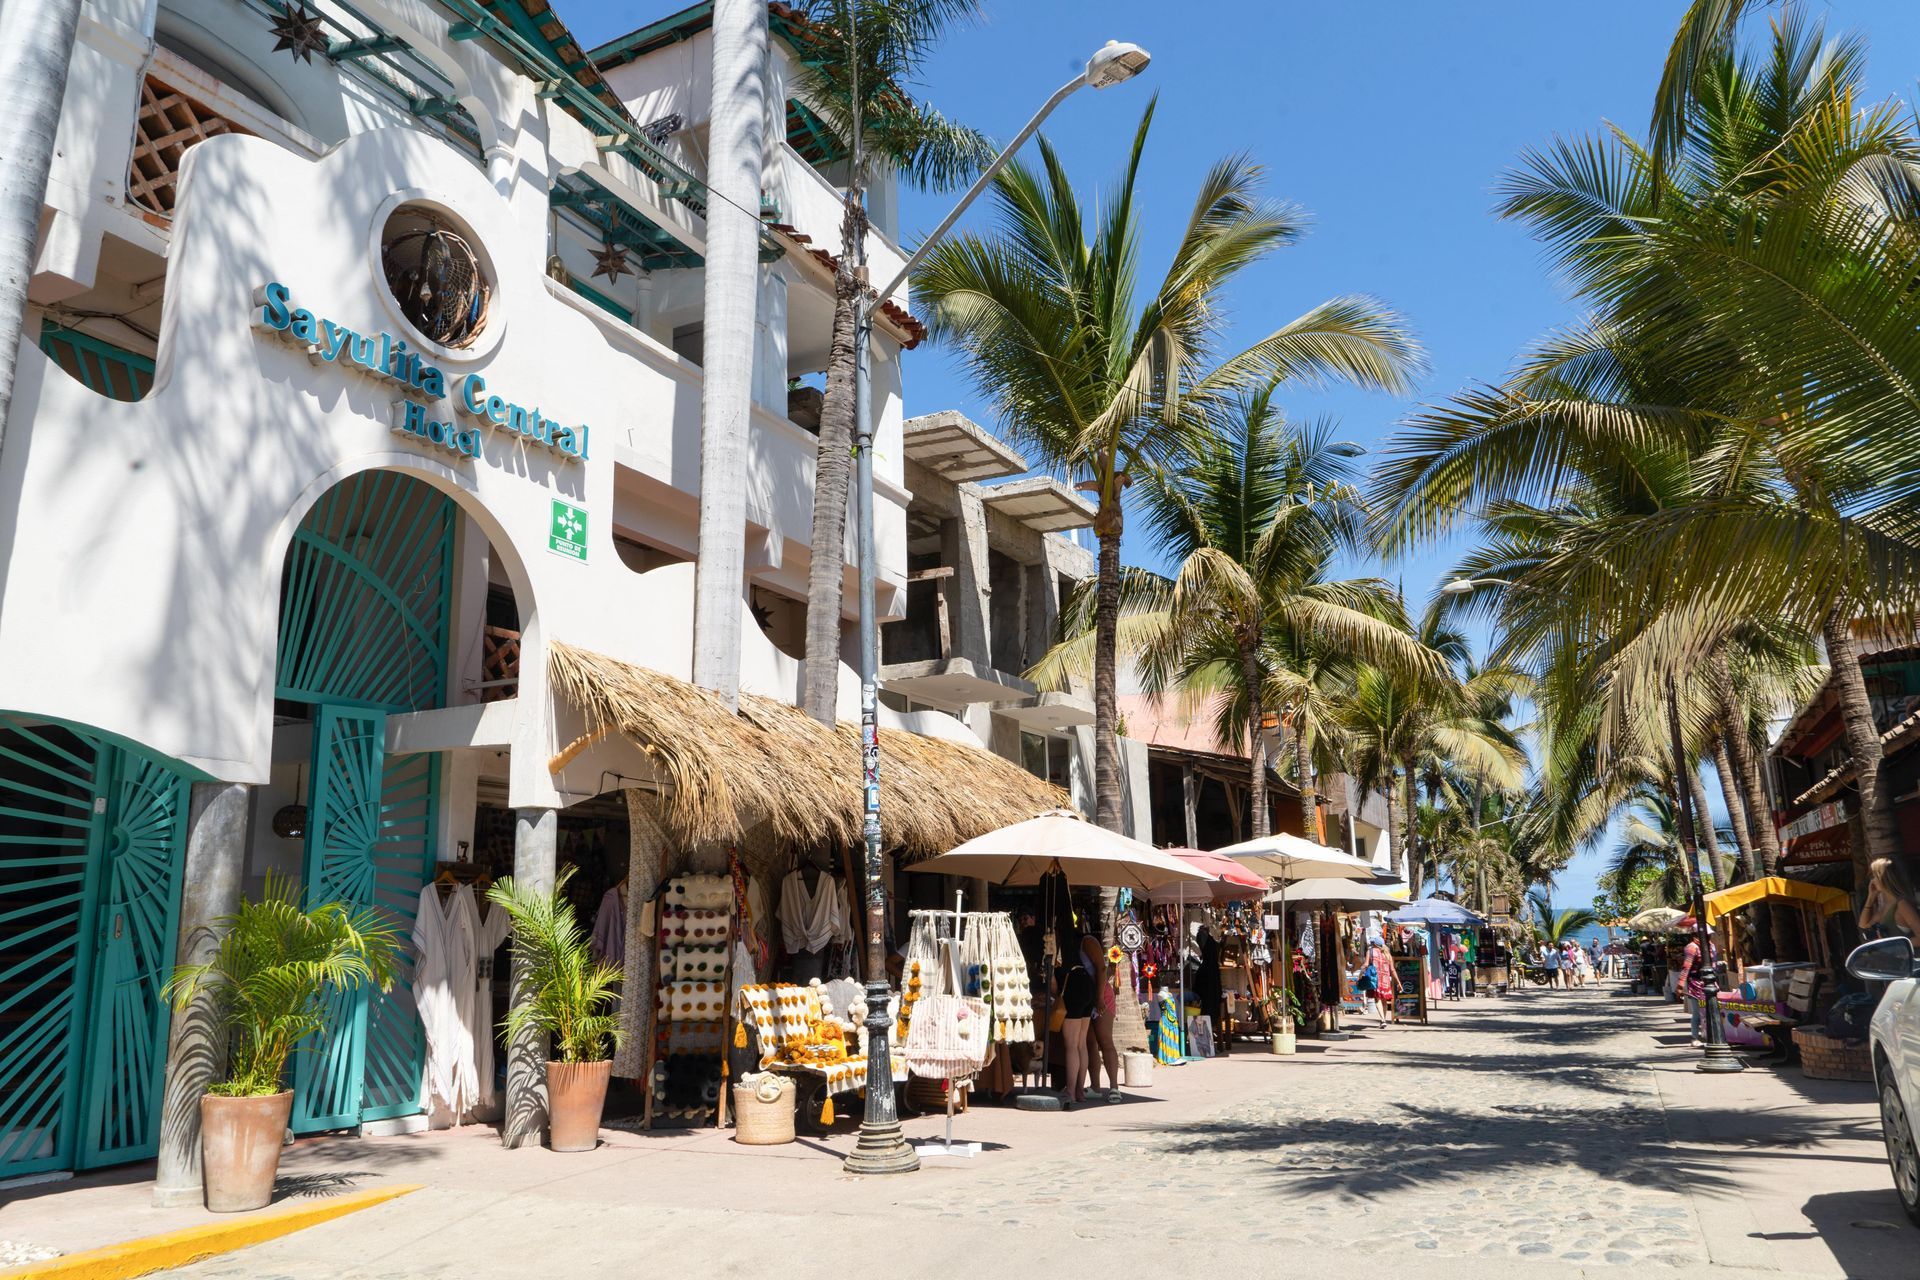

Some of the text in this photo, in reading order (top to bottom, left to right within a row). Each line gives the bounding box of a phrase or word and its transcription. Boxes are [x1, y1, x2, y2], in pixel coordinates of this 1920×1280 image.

[263, 282, 590, 461] Sayulita Central
[403, 400, 481, 459] Hotel
[555, 539, 573, 549] PUNTO
[1449, 967, 1457, 975] 30
